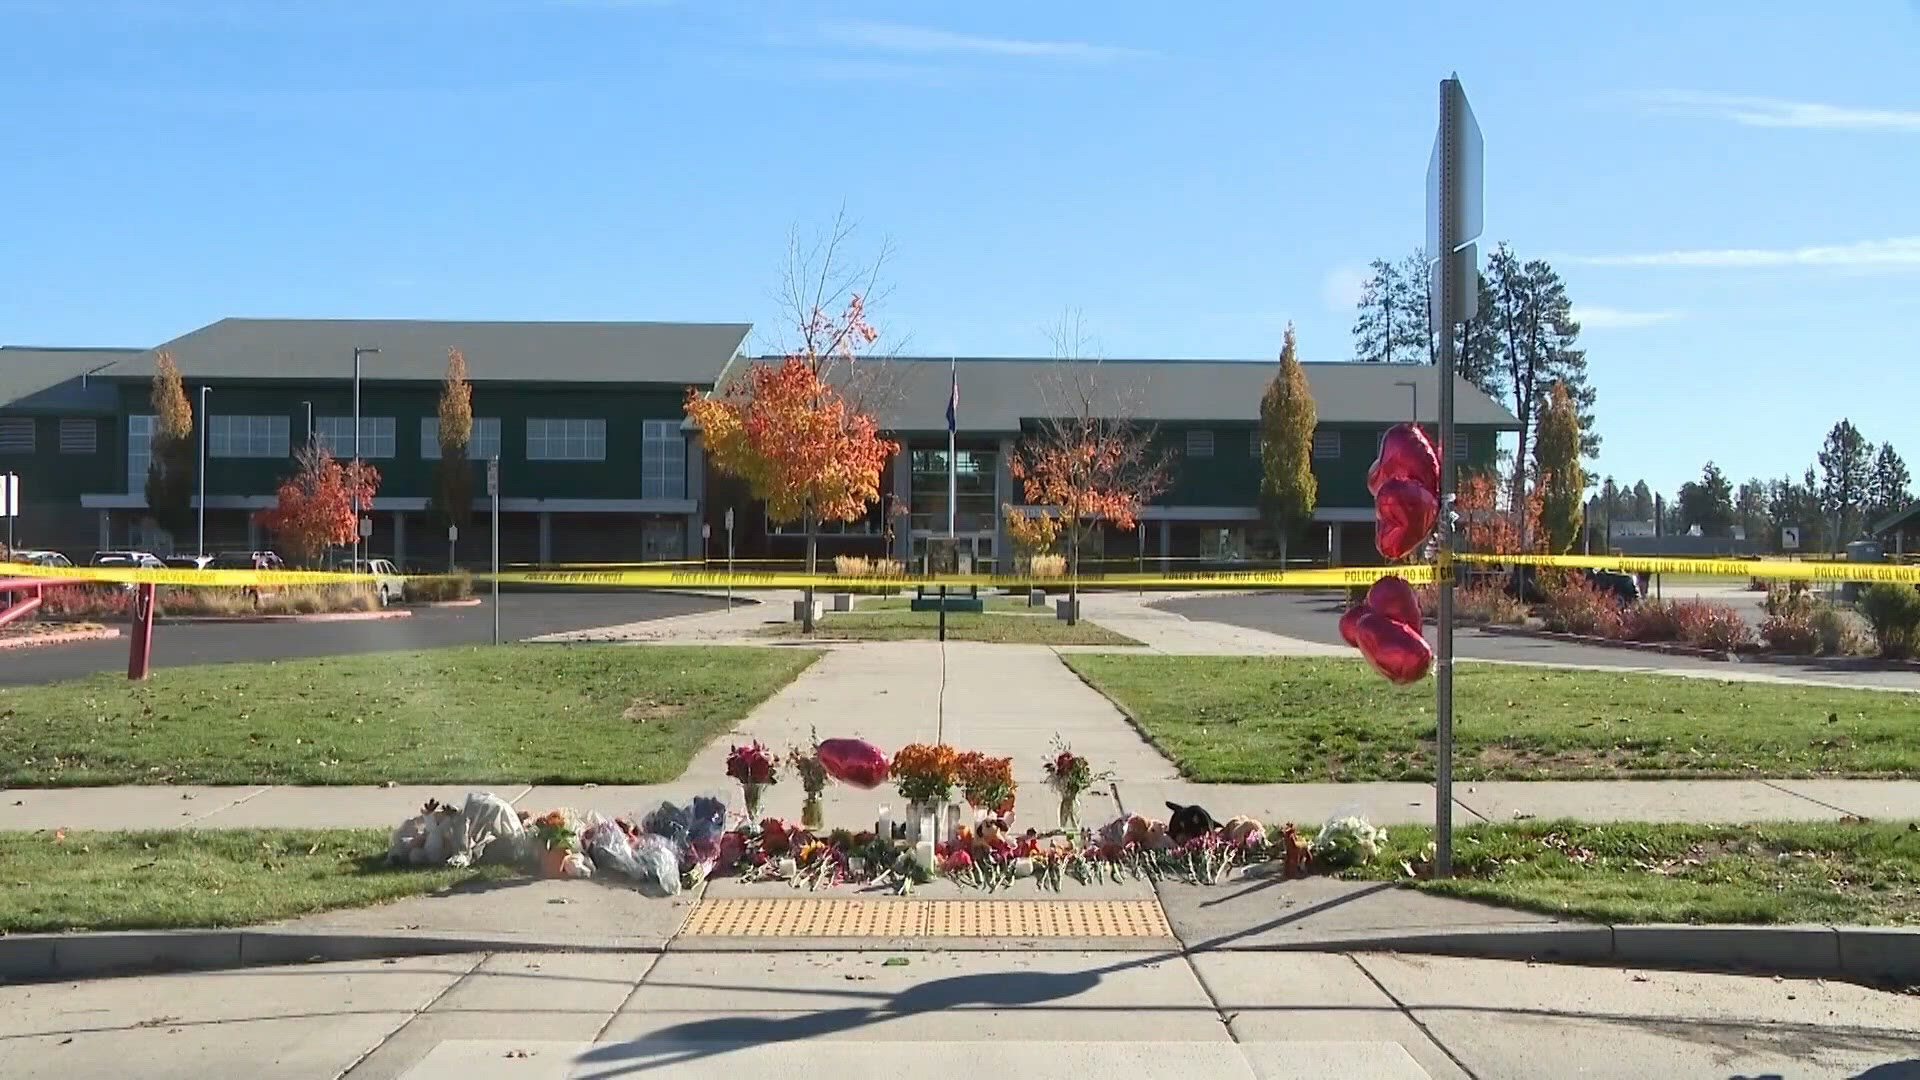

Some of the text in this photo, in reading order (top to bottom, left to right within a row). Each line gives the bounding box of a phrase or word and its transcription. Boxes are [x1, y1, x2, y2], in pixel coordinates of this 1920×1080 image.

[1344, 570, 1376, 582] POLICE
[1403, 569, 1416, 580] DO
[1419, 567, 1437, 580] NOT
[1619, 560, 1749, 575] POLICE LINE DO NOT CROSS
[1814, 566, 1915, 581] POLICE LINE DO NOT
[1163, 571, 1193, 580] POLICE
[1234, 571, 1250, 581] NOT
[1254, 570, 1284, 582] CROSS
